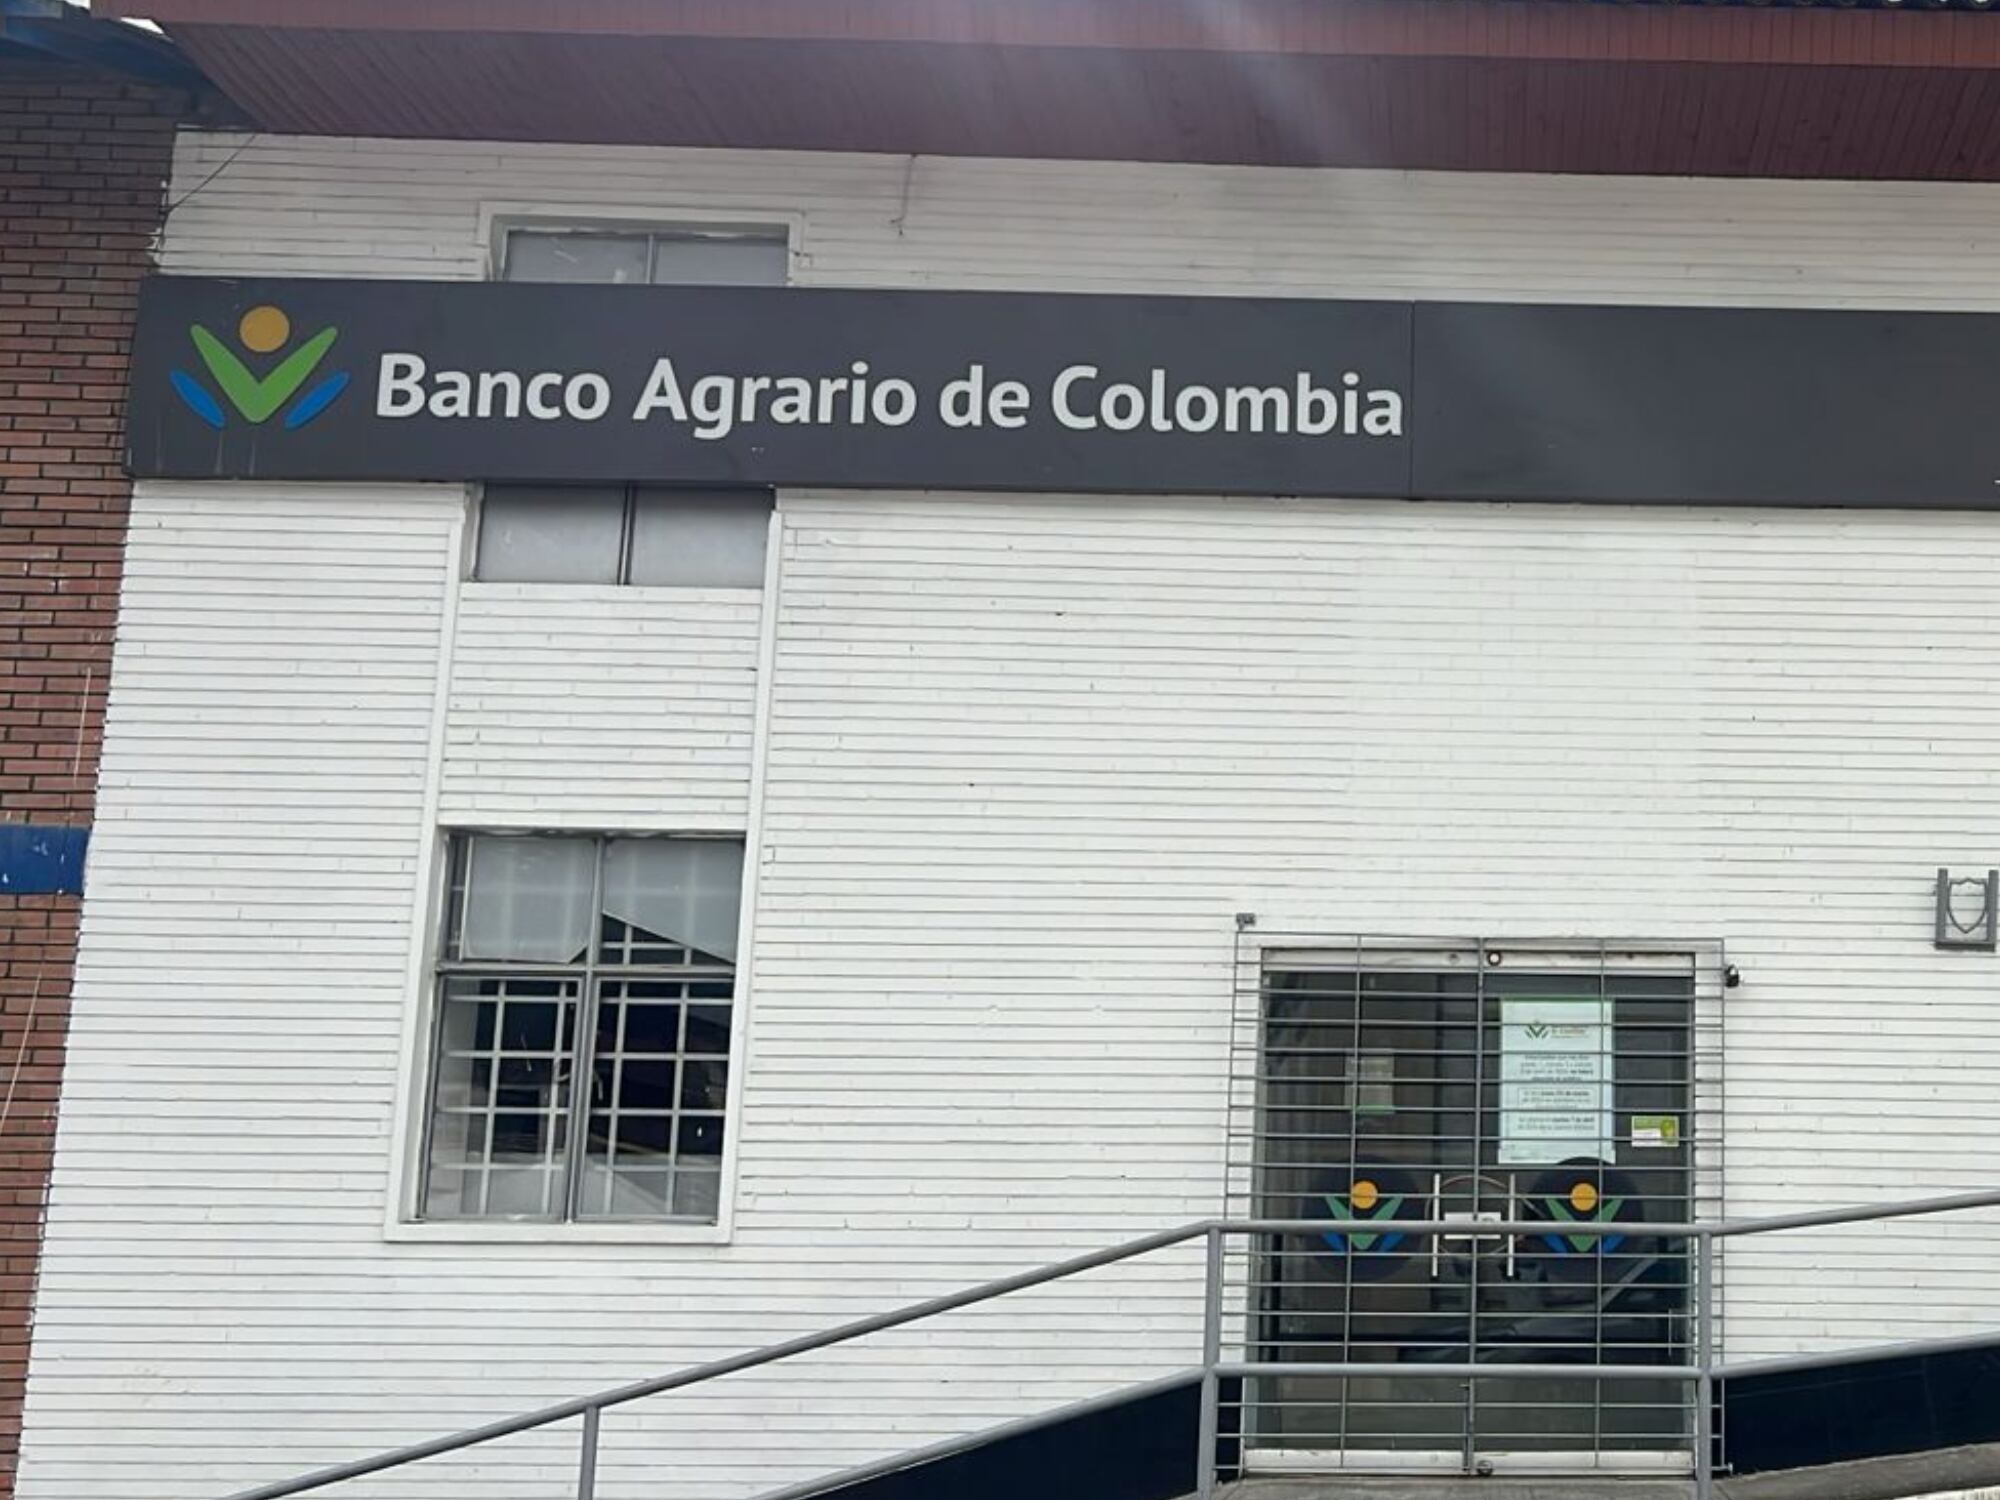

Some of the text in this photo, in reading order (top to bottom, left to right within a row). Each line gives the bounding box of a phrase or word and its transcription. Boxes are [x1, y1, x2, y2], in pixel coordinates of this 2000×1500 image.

[376, 353, 1403, 440] Banco Agrario de Colombia
